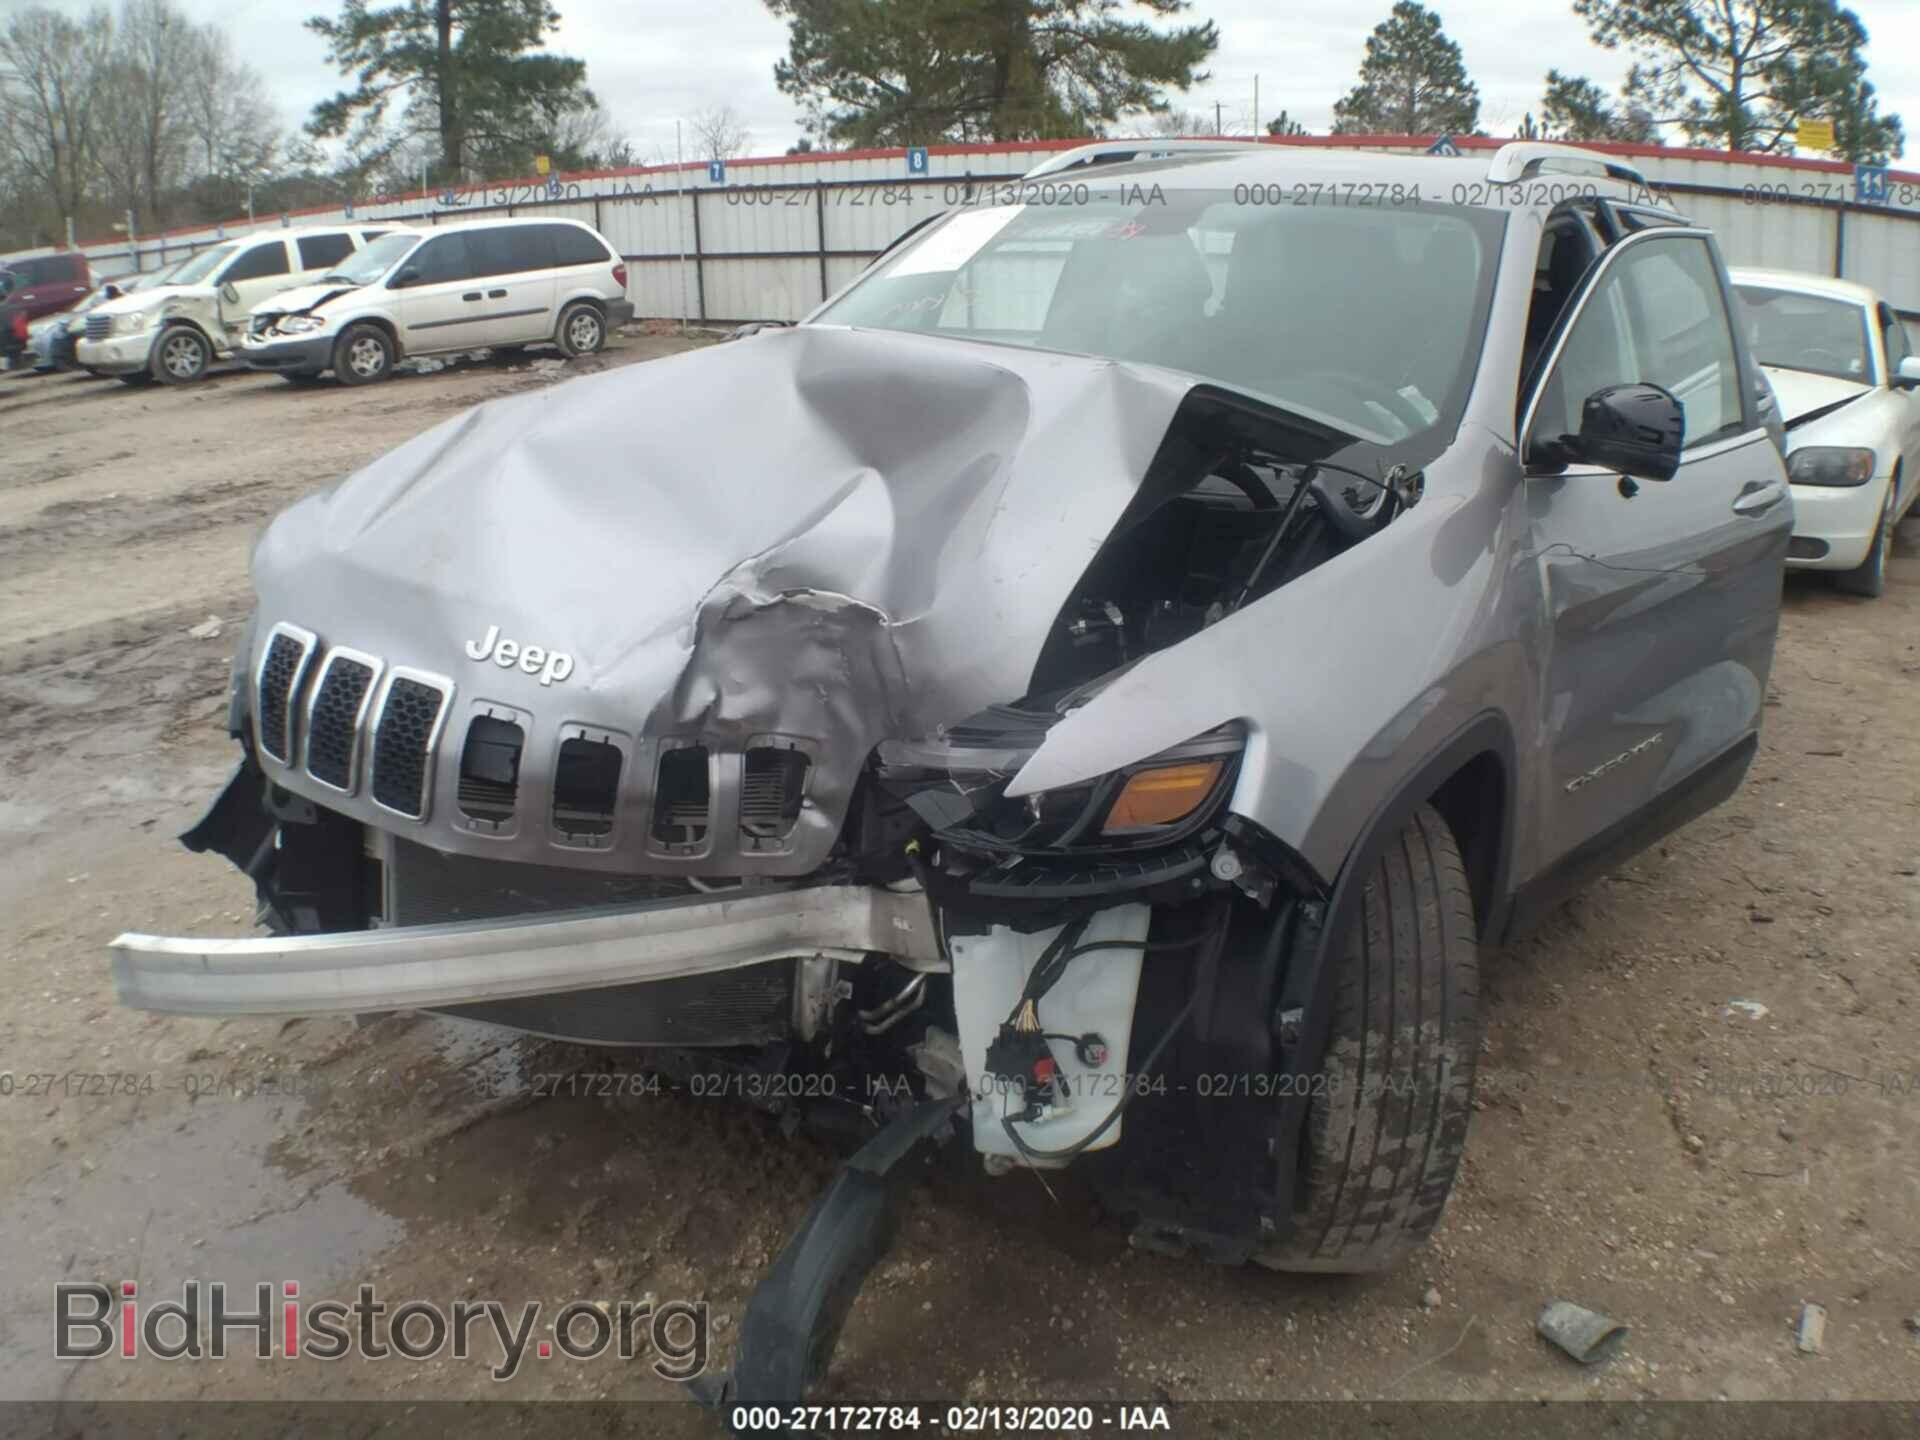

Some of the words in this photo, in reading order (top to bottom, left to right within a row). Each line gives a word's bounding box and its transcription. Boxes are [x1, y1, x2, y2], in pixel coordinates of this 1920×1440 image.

[912, 151, 923, 169] 8
[712, 163, 721, 180] 7
[1861, 171, 1884, 194] 11
[465, 625, 575, 687] Jeep
